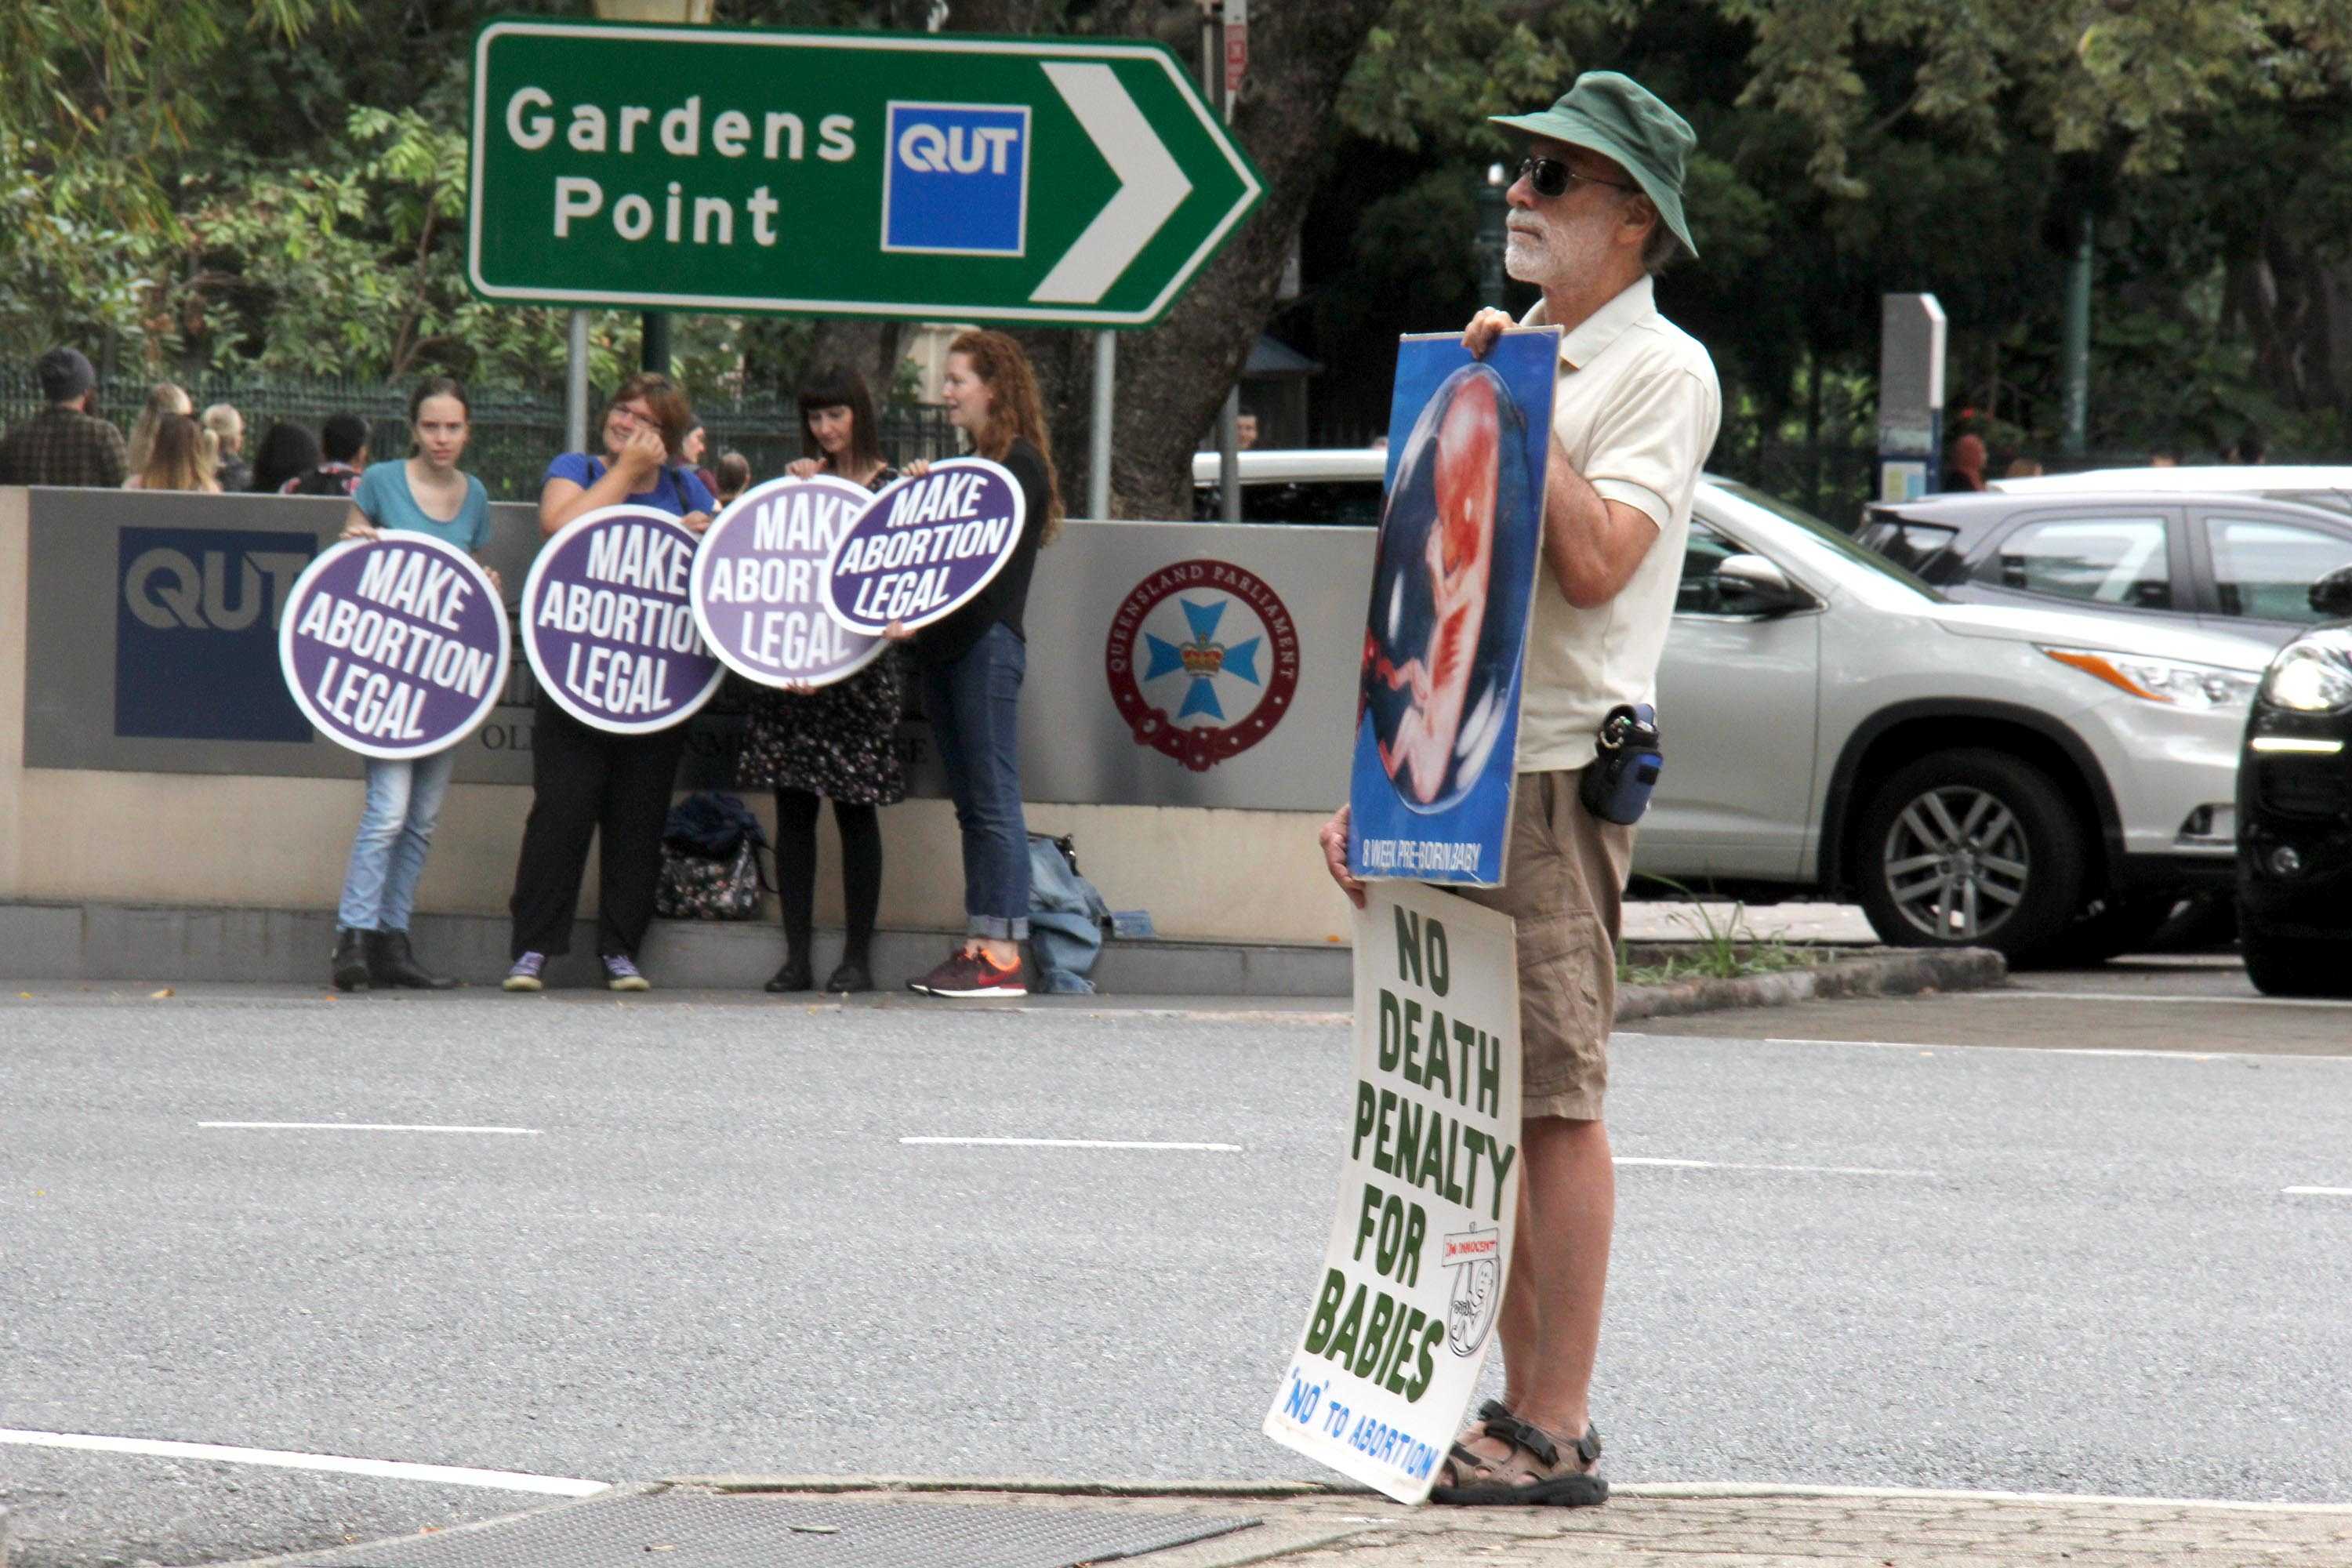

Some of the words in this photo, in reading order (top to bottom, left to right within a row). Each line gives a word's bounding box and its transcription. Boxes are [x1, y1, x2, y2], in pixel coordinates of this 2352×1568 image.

[506, 86, 856, 162] Gardens
[898, 123, 1018, 174] QUT
[554, 176, 779, 246] Point
[886, 472, 989, 528] MAKE
[586, 524, 693, 597] MAKE
[708, 557, 826, 604] ABORT
[836, 517, 1009, 577] ABORTION
[125, 547, 310, 630] QUT
[356, 548, 474, 632] MAKE
[853, 566, 950, 620] LEGAL
[1111, 564, 1204, 673] QUEENSLAND
[1213, 566, 1296, 679] PARLIAMENT
[297, 591, 494, 699] ABORTION
[565, 642, 673, 714] LEGAL
[740, 610, 852, 670] LEGAL
[315, 656, 427, 740] LEGAL
[1363, 839, 1370, 867] 8
[1371, 839, 1396, 868] WEEK
[1398, 840, 1450, 872] PRE-BORN
[1450, 842, 1482, 873] BABY
[1393, 904, 1449, 997] NO
[1379, 987, 1500, 1119] DEATH
[1352, 1079, 1516, 1221] PENALTY
[1353, 1182, 1427, 1288] FOR
[1304, 1267, 1444, 1403] BABIES
[1323, 1401, 1349, 1438] TO
[1348, 1415, 1439, 1480] ABORTION
